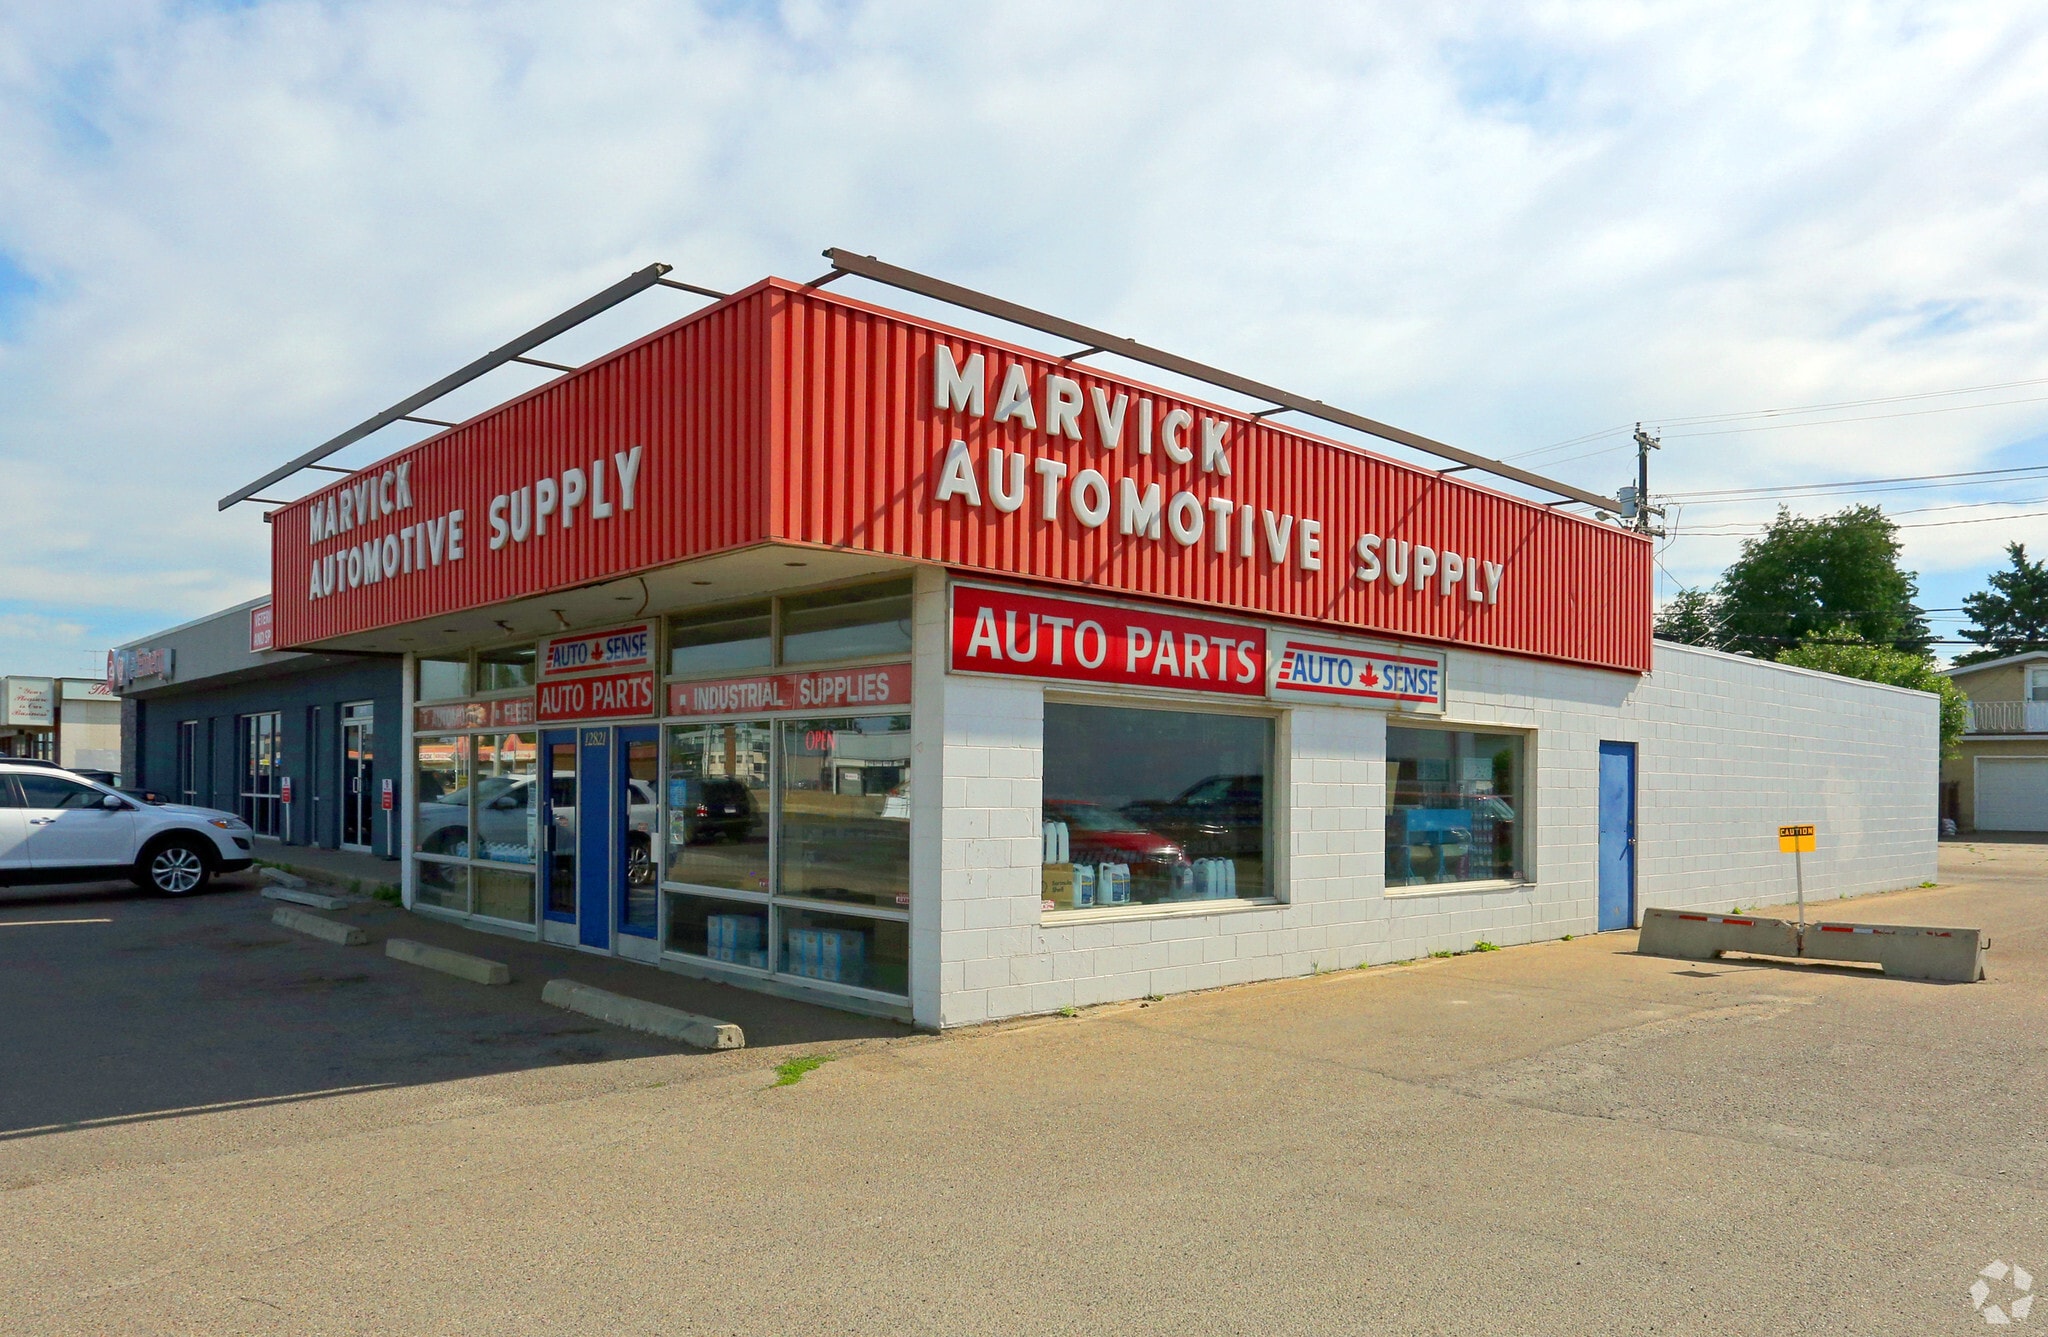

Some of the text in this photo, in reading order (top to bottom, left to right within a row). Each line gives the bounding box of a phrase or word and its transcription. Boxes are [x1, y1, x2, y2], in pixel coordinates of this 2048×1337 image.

[934, 344, 1230, 477] MARVICK
[309, 445, 643, 601] AUTOMOTIVE SUPPLY
[310, 460, 413, 545] MARVICK
[934, 439, 1503, 605] AUTOMOTIVE SUPPLY
[553, 633, 647, 668] AUTO SENSE
[966, 607, 1256, 684] AUTO PARTS
[694, 672, 890, 710] INDUSTRIAL SUPPLIES
[1292, 653, 1438, 695] AUTO SENSE
[540, 677, 653, 714] AUTO PARTS
[806, 730, 835, 750] OPEN
[1780, 827, 1813, 836] CAUTION
